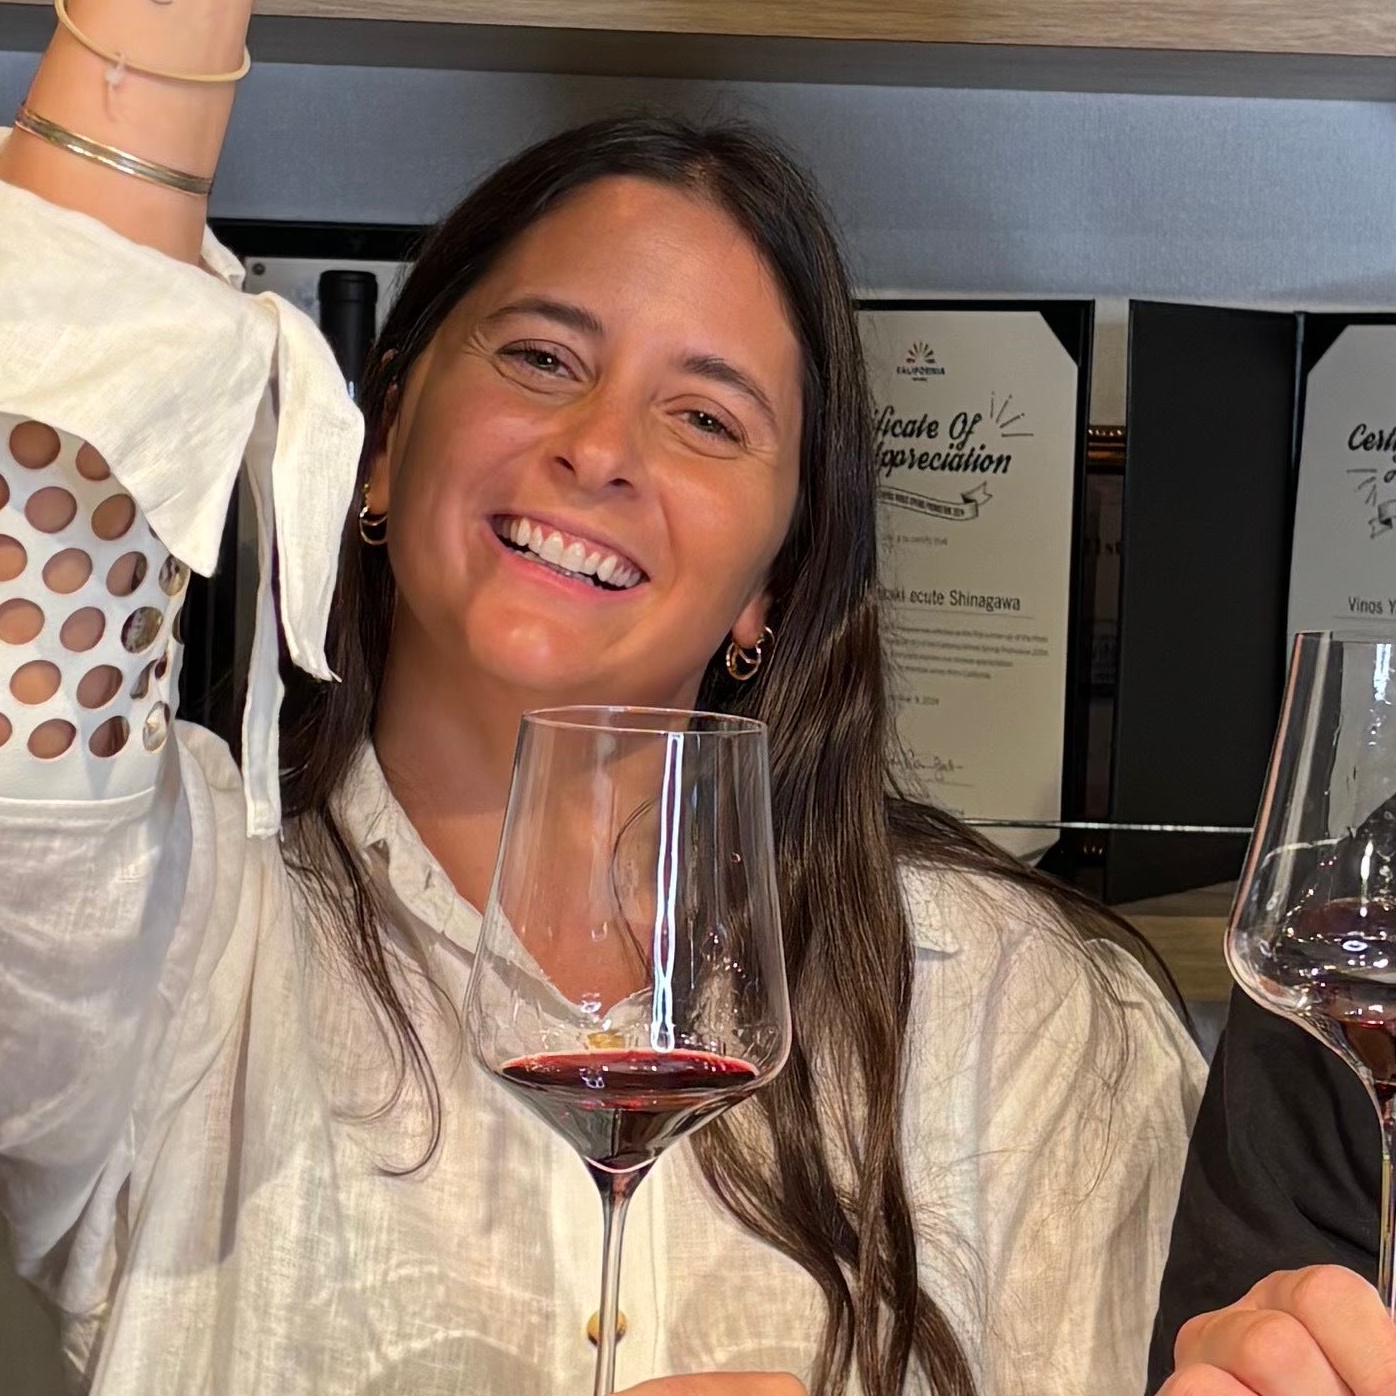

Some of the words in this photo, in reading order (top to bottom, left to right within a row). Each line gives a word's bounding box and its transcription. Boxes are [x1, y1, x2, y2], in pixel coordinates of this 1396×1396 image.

[949, 411, 983, 451] Of
[909, 590, 945, 605] ecute
[949, 589, 1021, 612] Shinagawa
[1348, 597, 1383, 614] Vinos
